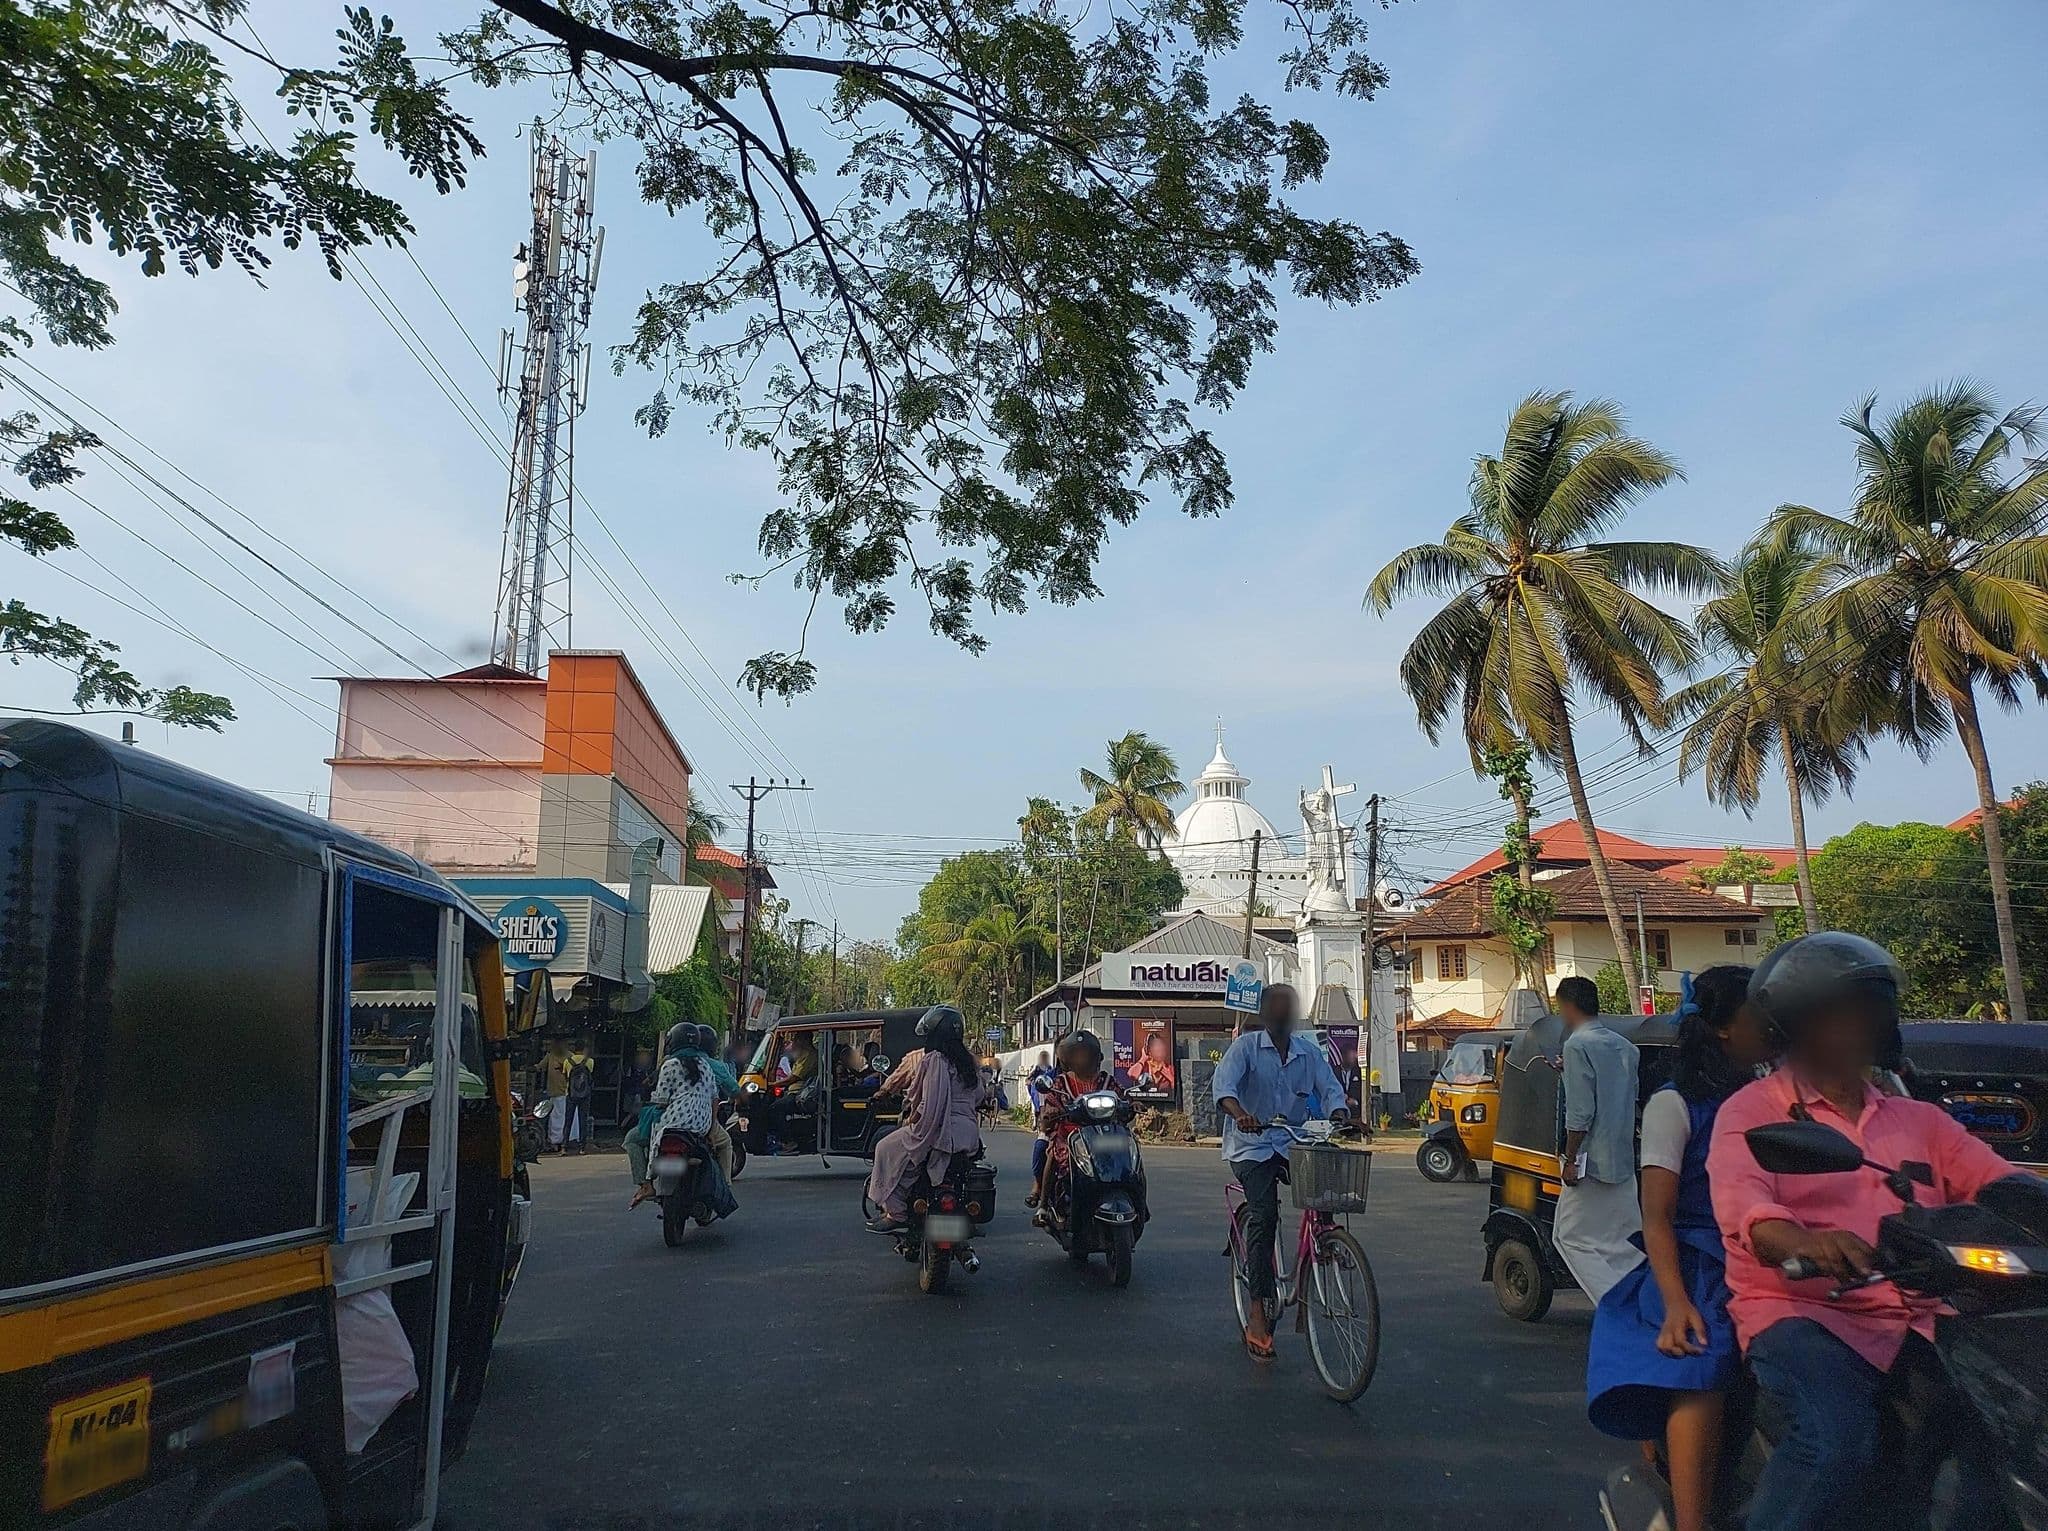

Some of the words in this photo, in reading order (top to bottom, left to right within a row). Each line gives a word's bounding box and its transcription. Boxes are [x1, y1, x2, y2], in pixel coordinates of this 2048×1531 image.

[498, 915, 558, 938] SHEIK'S
[505, 939, 556, 953] JUNCTION
[1242, 989, 1258, 998] ISM
